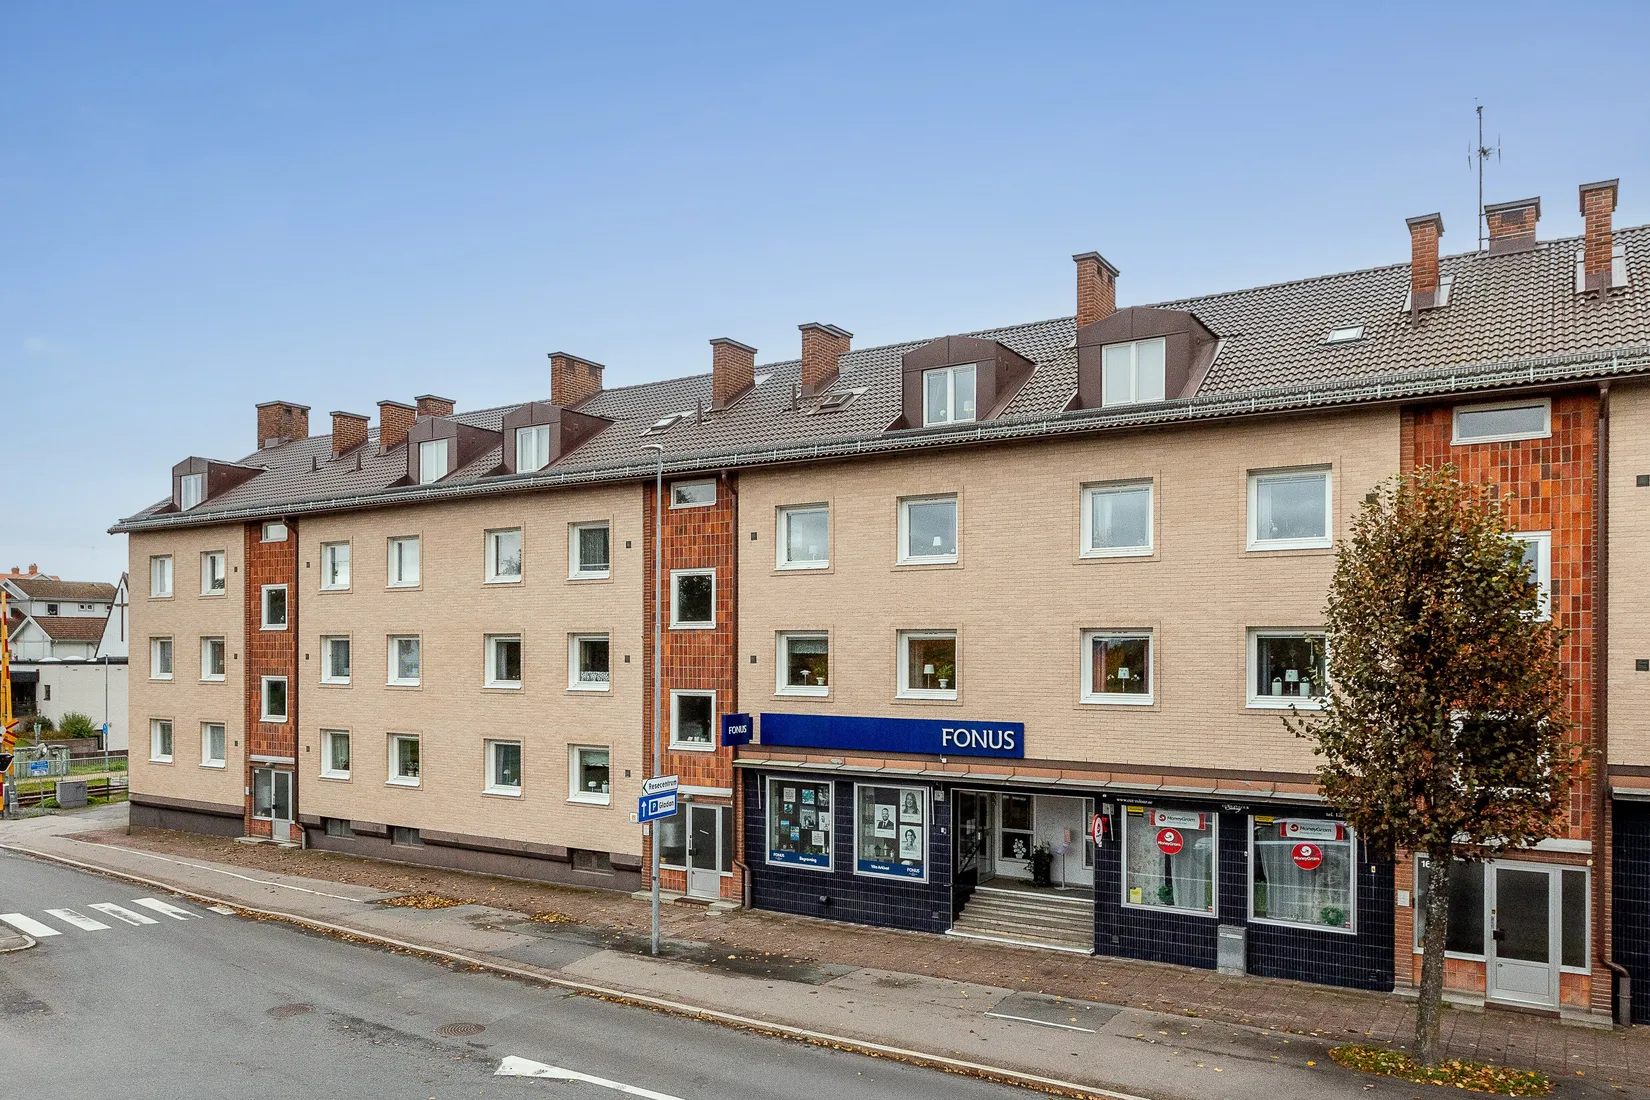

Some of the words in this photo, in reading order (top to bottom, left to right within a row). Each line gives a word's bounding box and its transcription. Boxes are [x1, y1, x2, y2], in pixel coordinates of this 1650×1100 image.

[728, 725, 747, 735] FONUS
[941, 728, 1015, 750] FONUS
[648, 780, 677, 791] Resecentrum
[1300, 825, 1332, 833] MoneyGram
